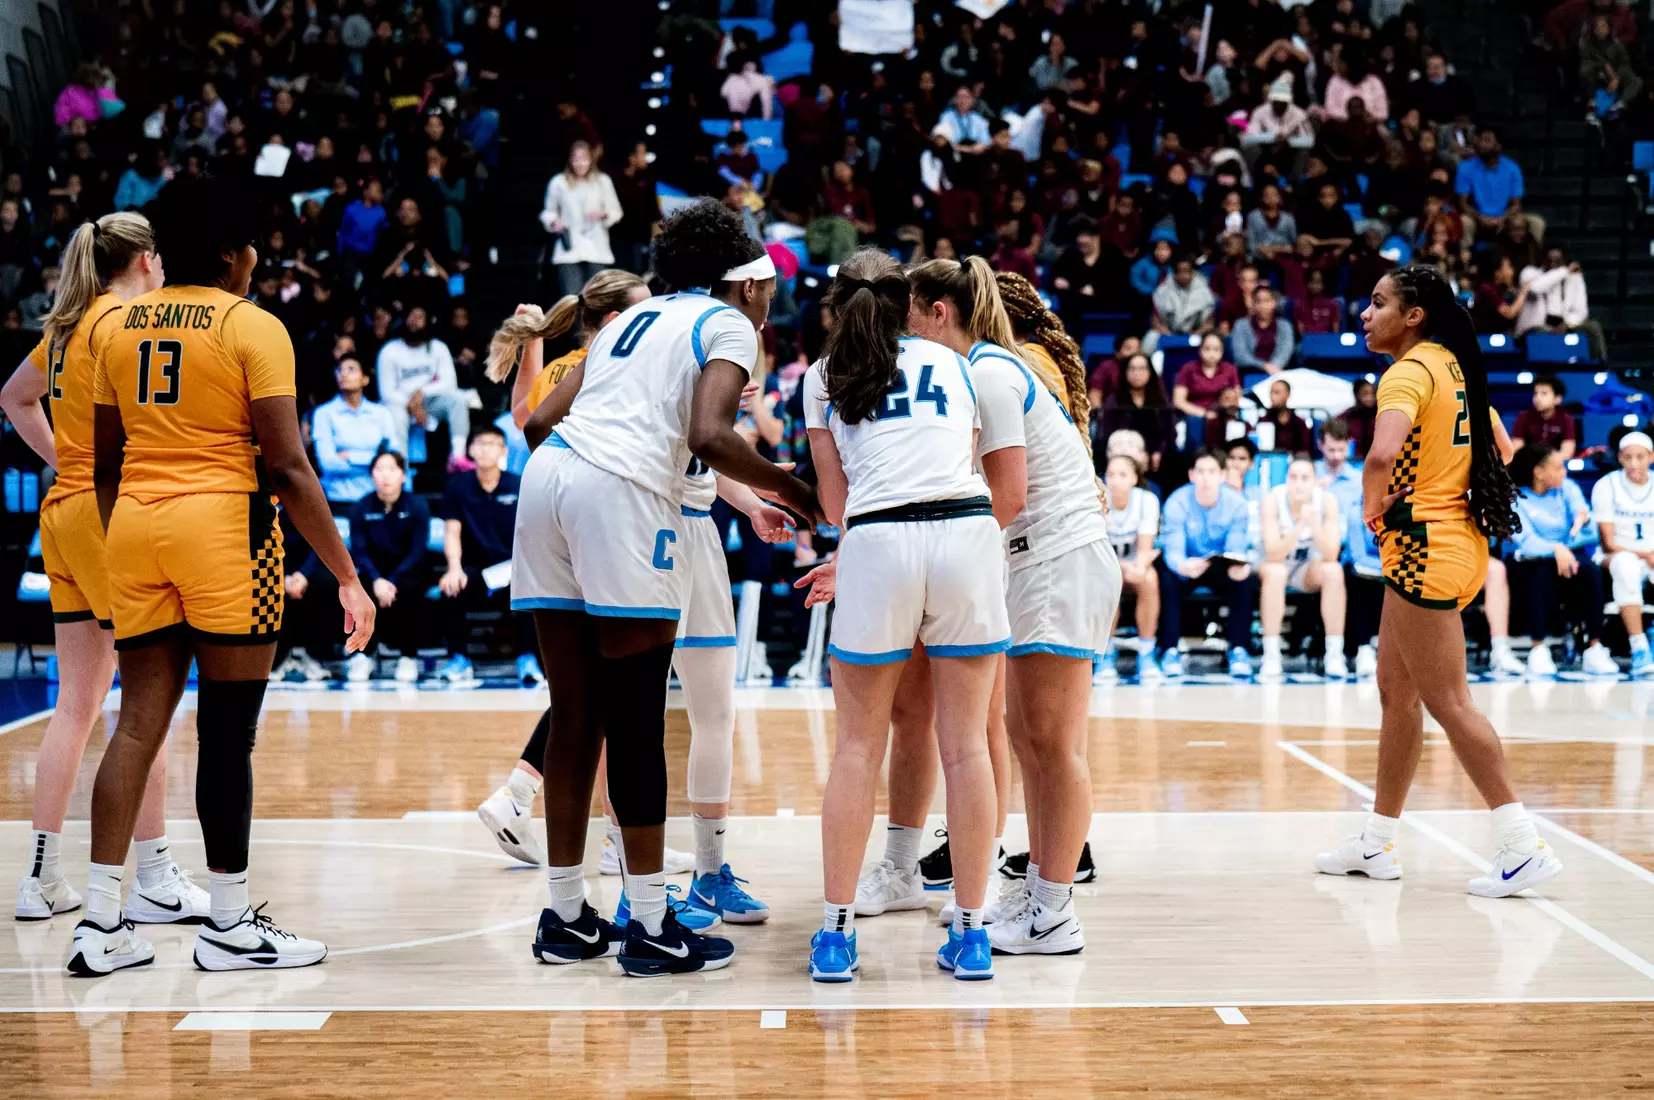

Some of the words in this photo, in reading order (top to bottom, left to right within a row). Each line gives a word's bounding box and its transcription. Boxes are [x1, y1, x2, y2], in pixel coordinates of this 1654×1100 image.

[124, 304, 152, 330] DOS
[152, 303, 216, 330] SANTOS
[610, 310, 662, 358] 0
[137, 338, 183, 406] 13
[874, 365, 949, 422] 24
[651, 528, 677, 572] C
